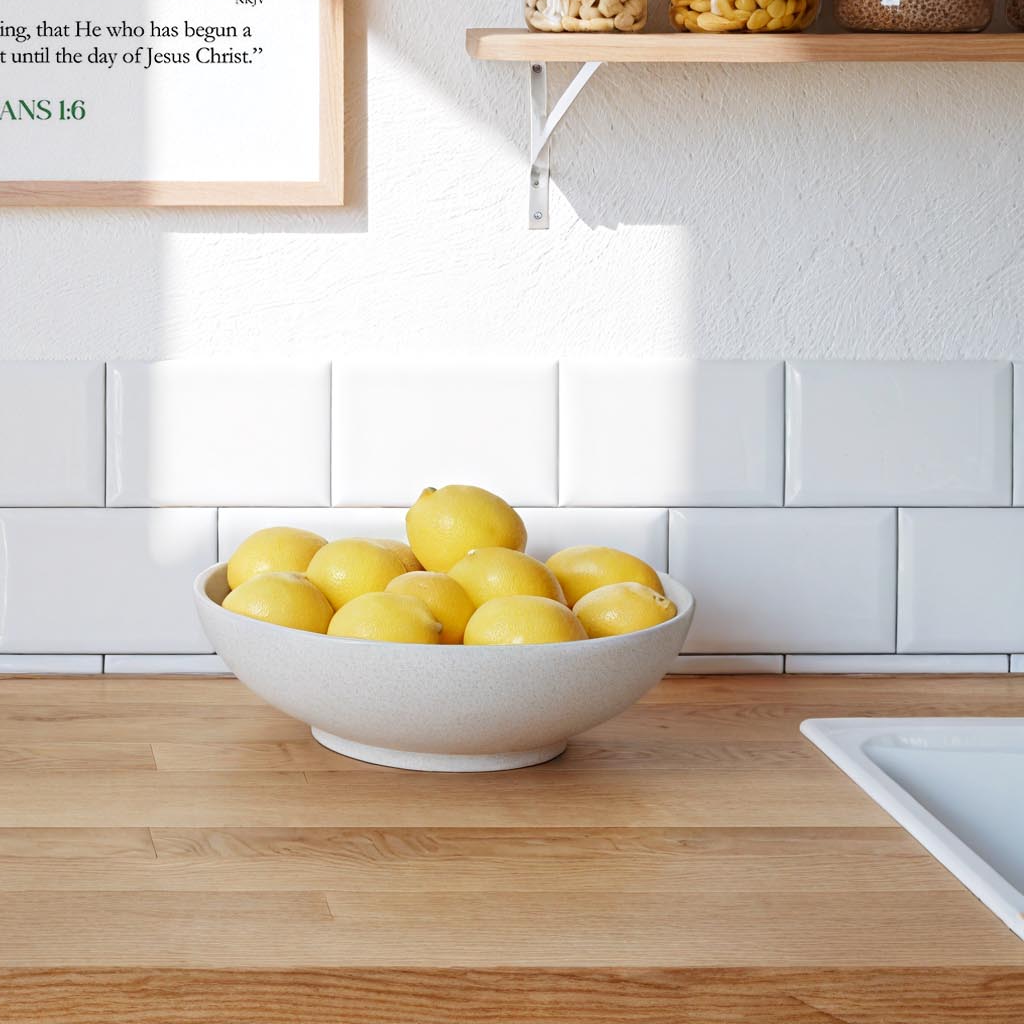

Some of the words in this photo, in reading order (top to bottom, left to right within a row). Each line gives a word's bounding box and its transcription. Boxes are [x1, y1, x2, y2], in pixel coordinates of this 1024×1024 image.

[36, 21, 70, 37] that
[75, 21, 101, 37] He
[106, 21, 144, 37] who
[150, 21, 179, 37] has
[184, 20, 237, 43] begun
[243, 26, 253, 37] a
[11, 47, 50, 63] until
[56, 47, 82, 63] the
[88, 47, 118, 69] day
[122, 47, 143, 63] of
[144, 47, 190, 69] Jesus
[196, 46, 263, 64] Christ.”
[59, 100, 87, 120] 1:6
